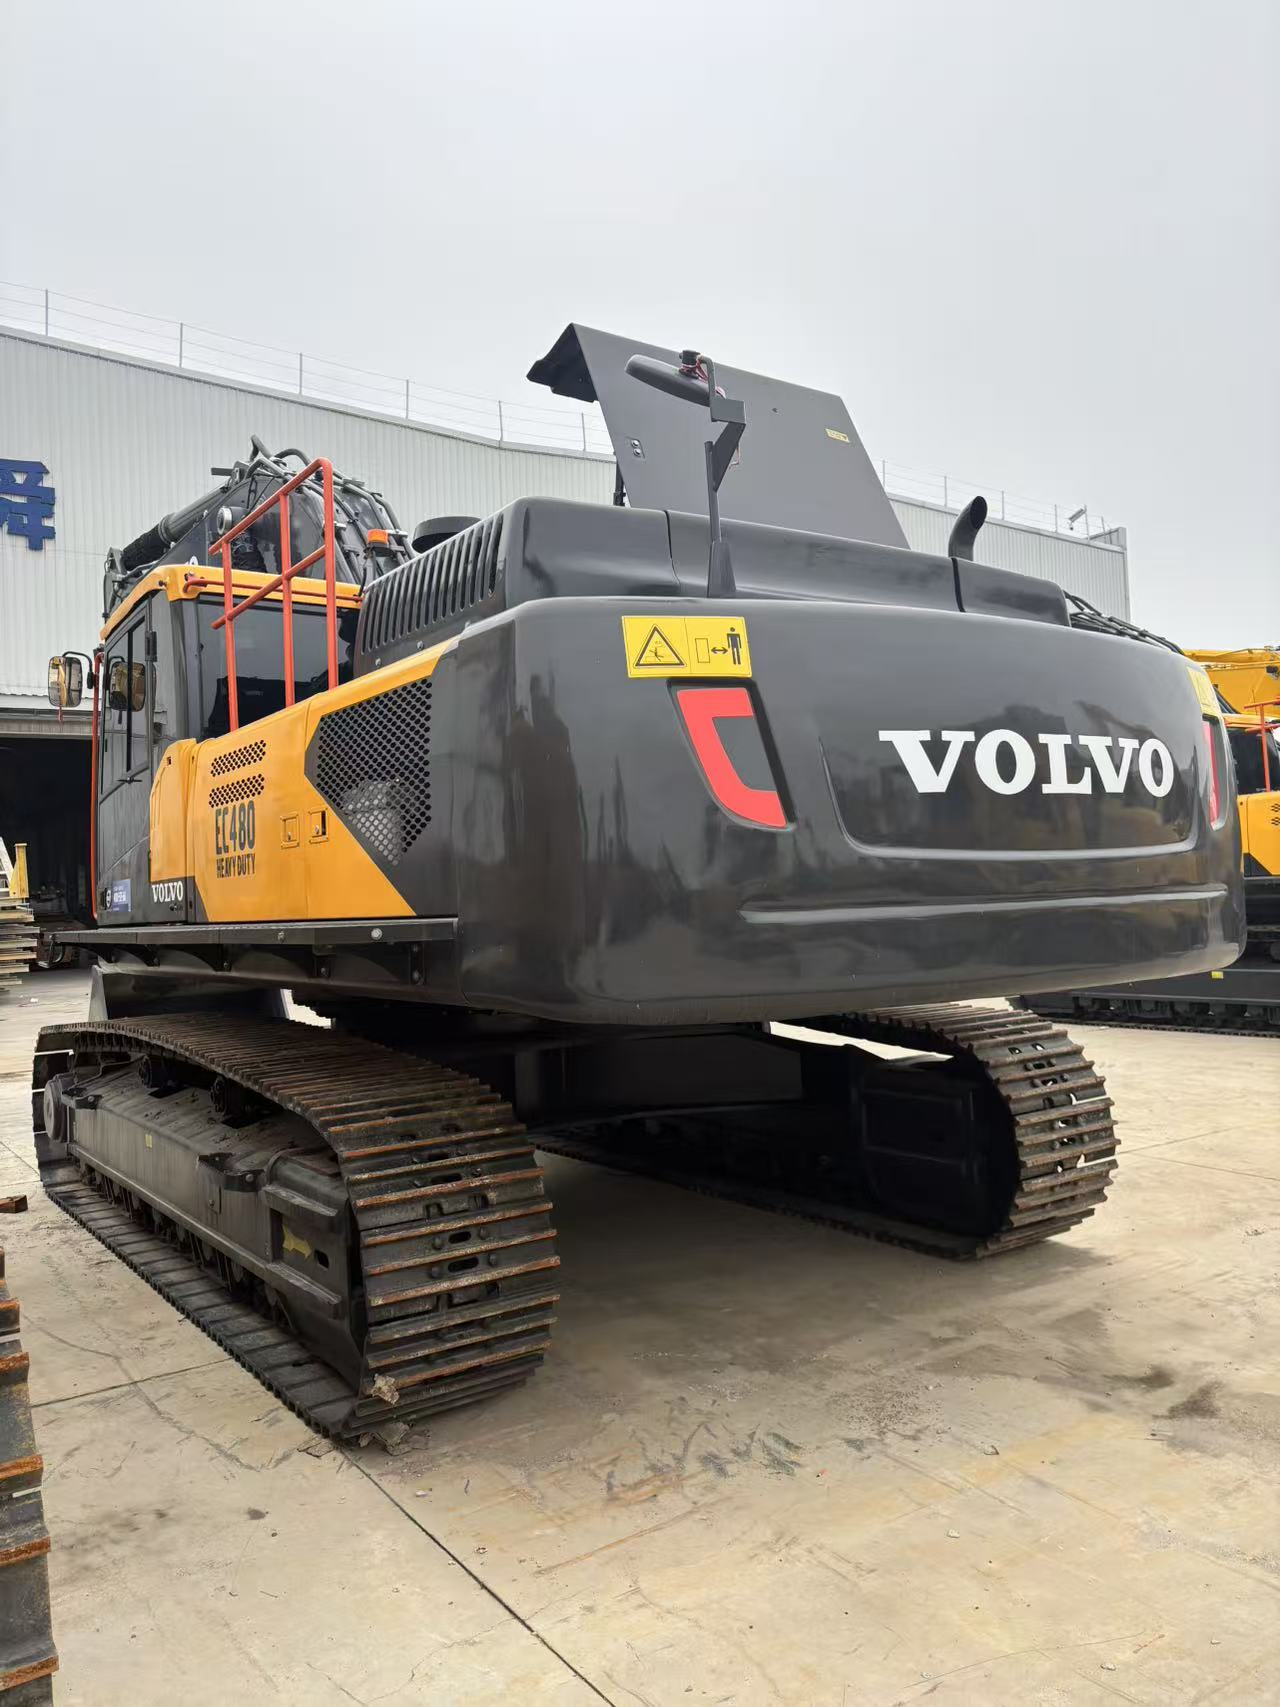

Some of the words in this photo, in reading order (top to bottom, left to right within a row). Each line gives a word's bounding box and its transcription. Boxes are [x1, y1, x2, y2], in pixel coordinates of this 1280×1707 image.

[878, 729, 1174, 797] VOLVO
[216, 800, 255, 855] EC480
[217, 856, 236, 878] HEAVY
[237, 853, 256, 876] DUTY
[152, 881, 183, 902] VOLVO
